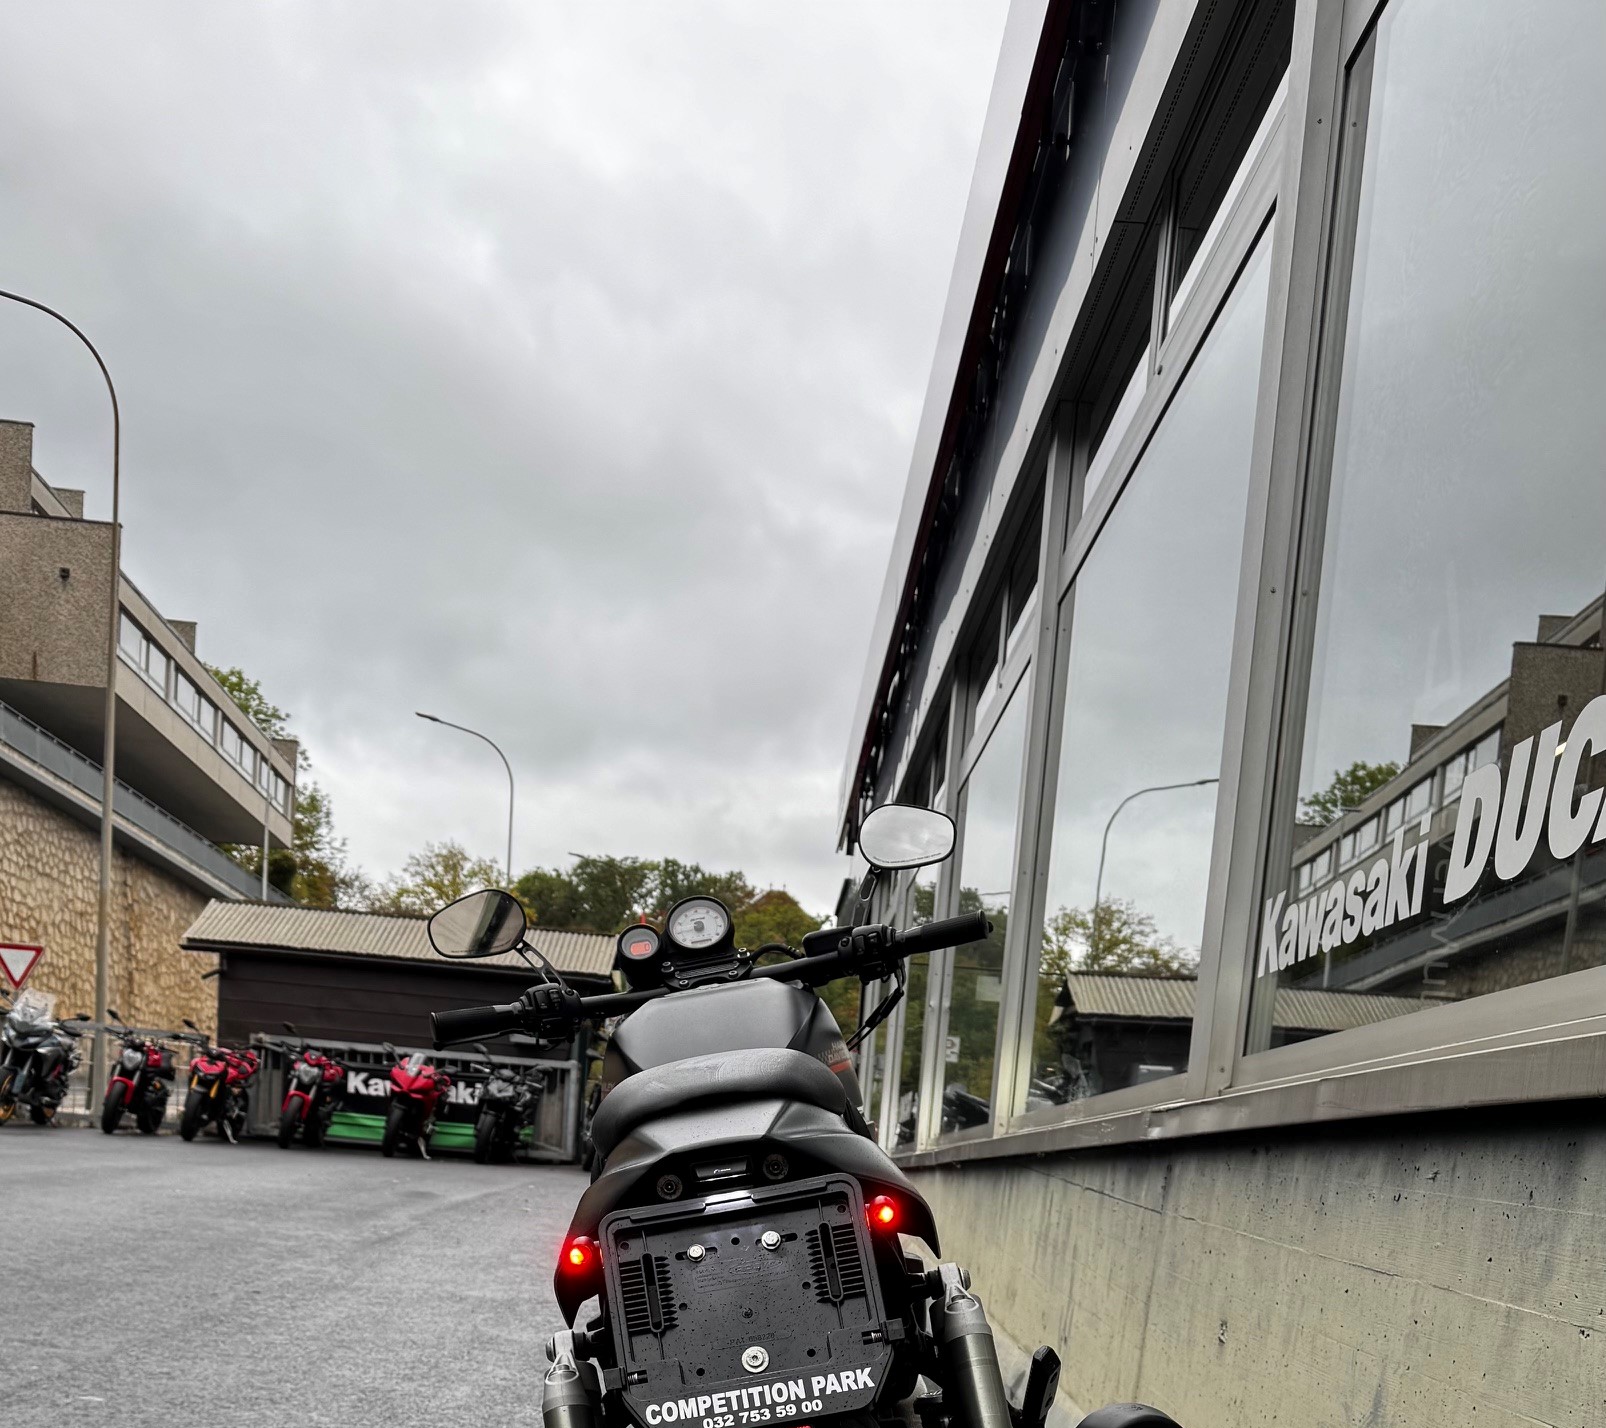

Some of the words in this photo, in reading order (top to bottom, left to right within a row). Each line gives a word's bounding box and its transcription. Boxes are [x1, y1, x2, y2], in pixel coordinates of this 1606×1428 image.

[1257, 810, 1433, 979] Kawasaki
[1443, 694, 1606, 904] DUC
[645, 1378, 806, 1426] COMPETITION
[811, 1367, 876, 1397] PARK
[738, 1407, 772, 1424] 753
[775, 1403, 797, 1418] 59
[801, 1398, 823, 1413] 00
